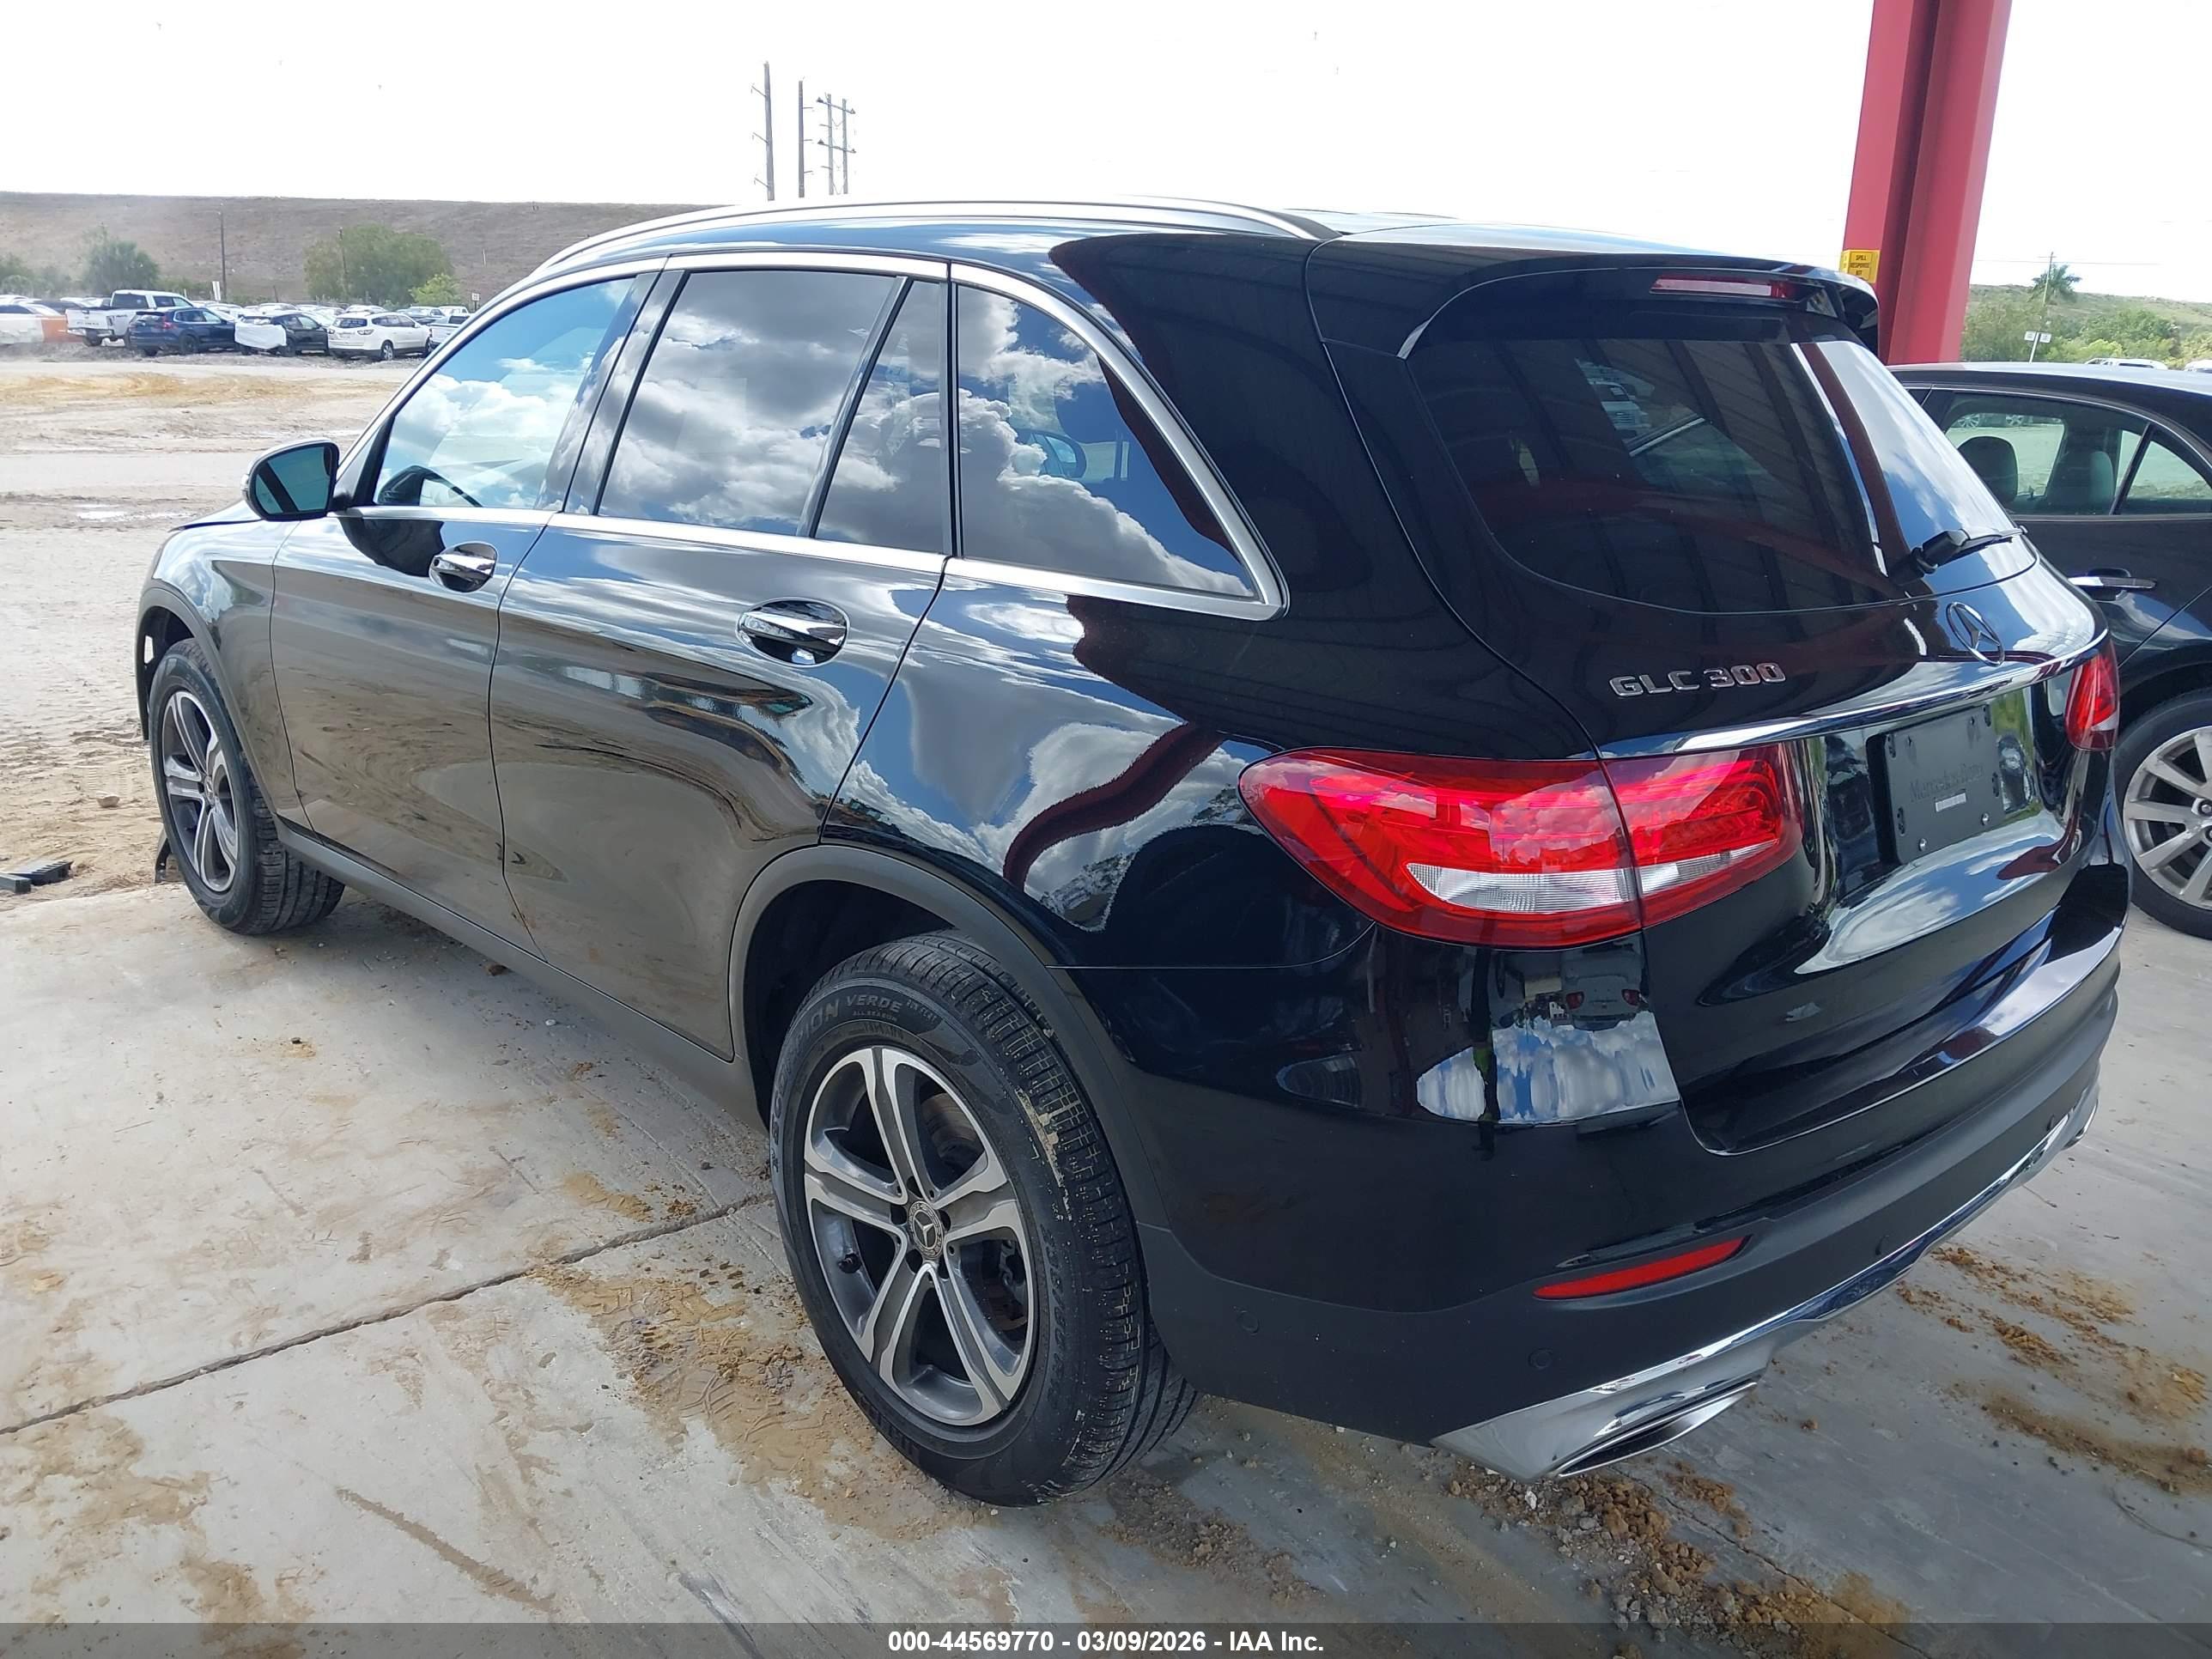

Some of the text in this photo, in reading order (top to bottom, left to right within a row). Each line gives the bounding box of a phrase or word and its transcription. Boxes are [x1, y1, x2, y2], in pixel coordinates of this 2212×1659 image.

[1609, 662, 1787, 696] GLC 300
[845, 994, 903, 1013] VERDE
